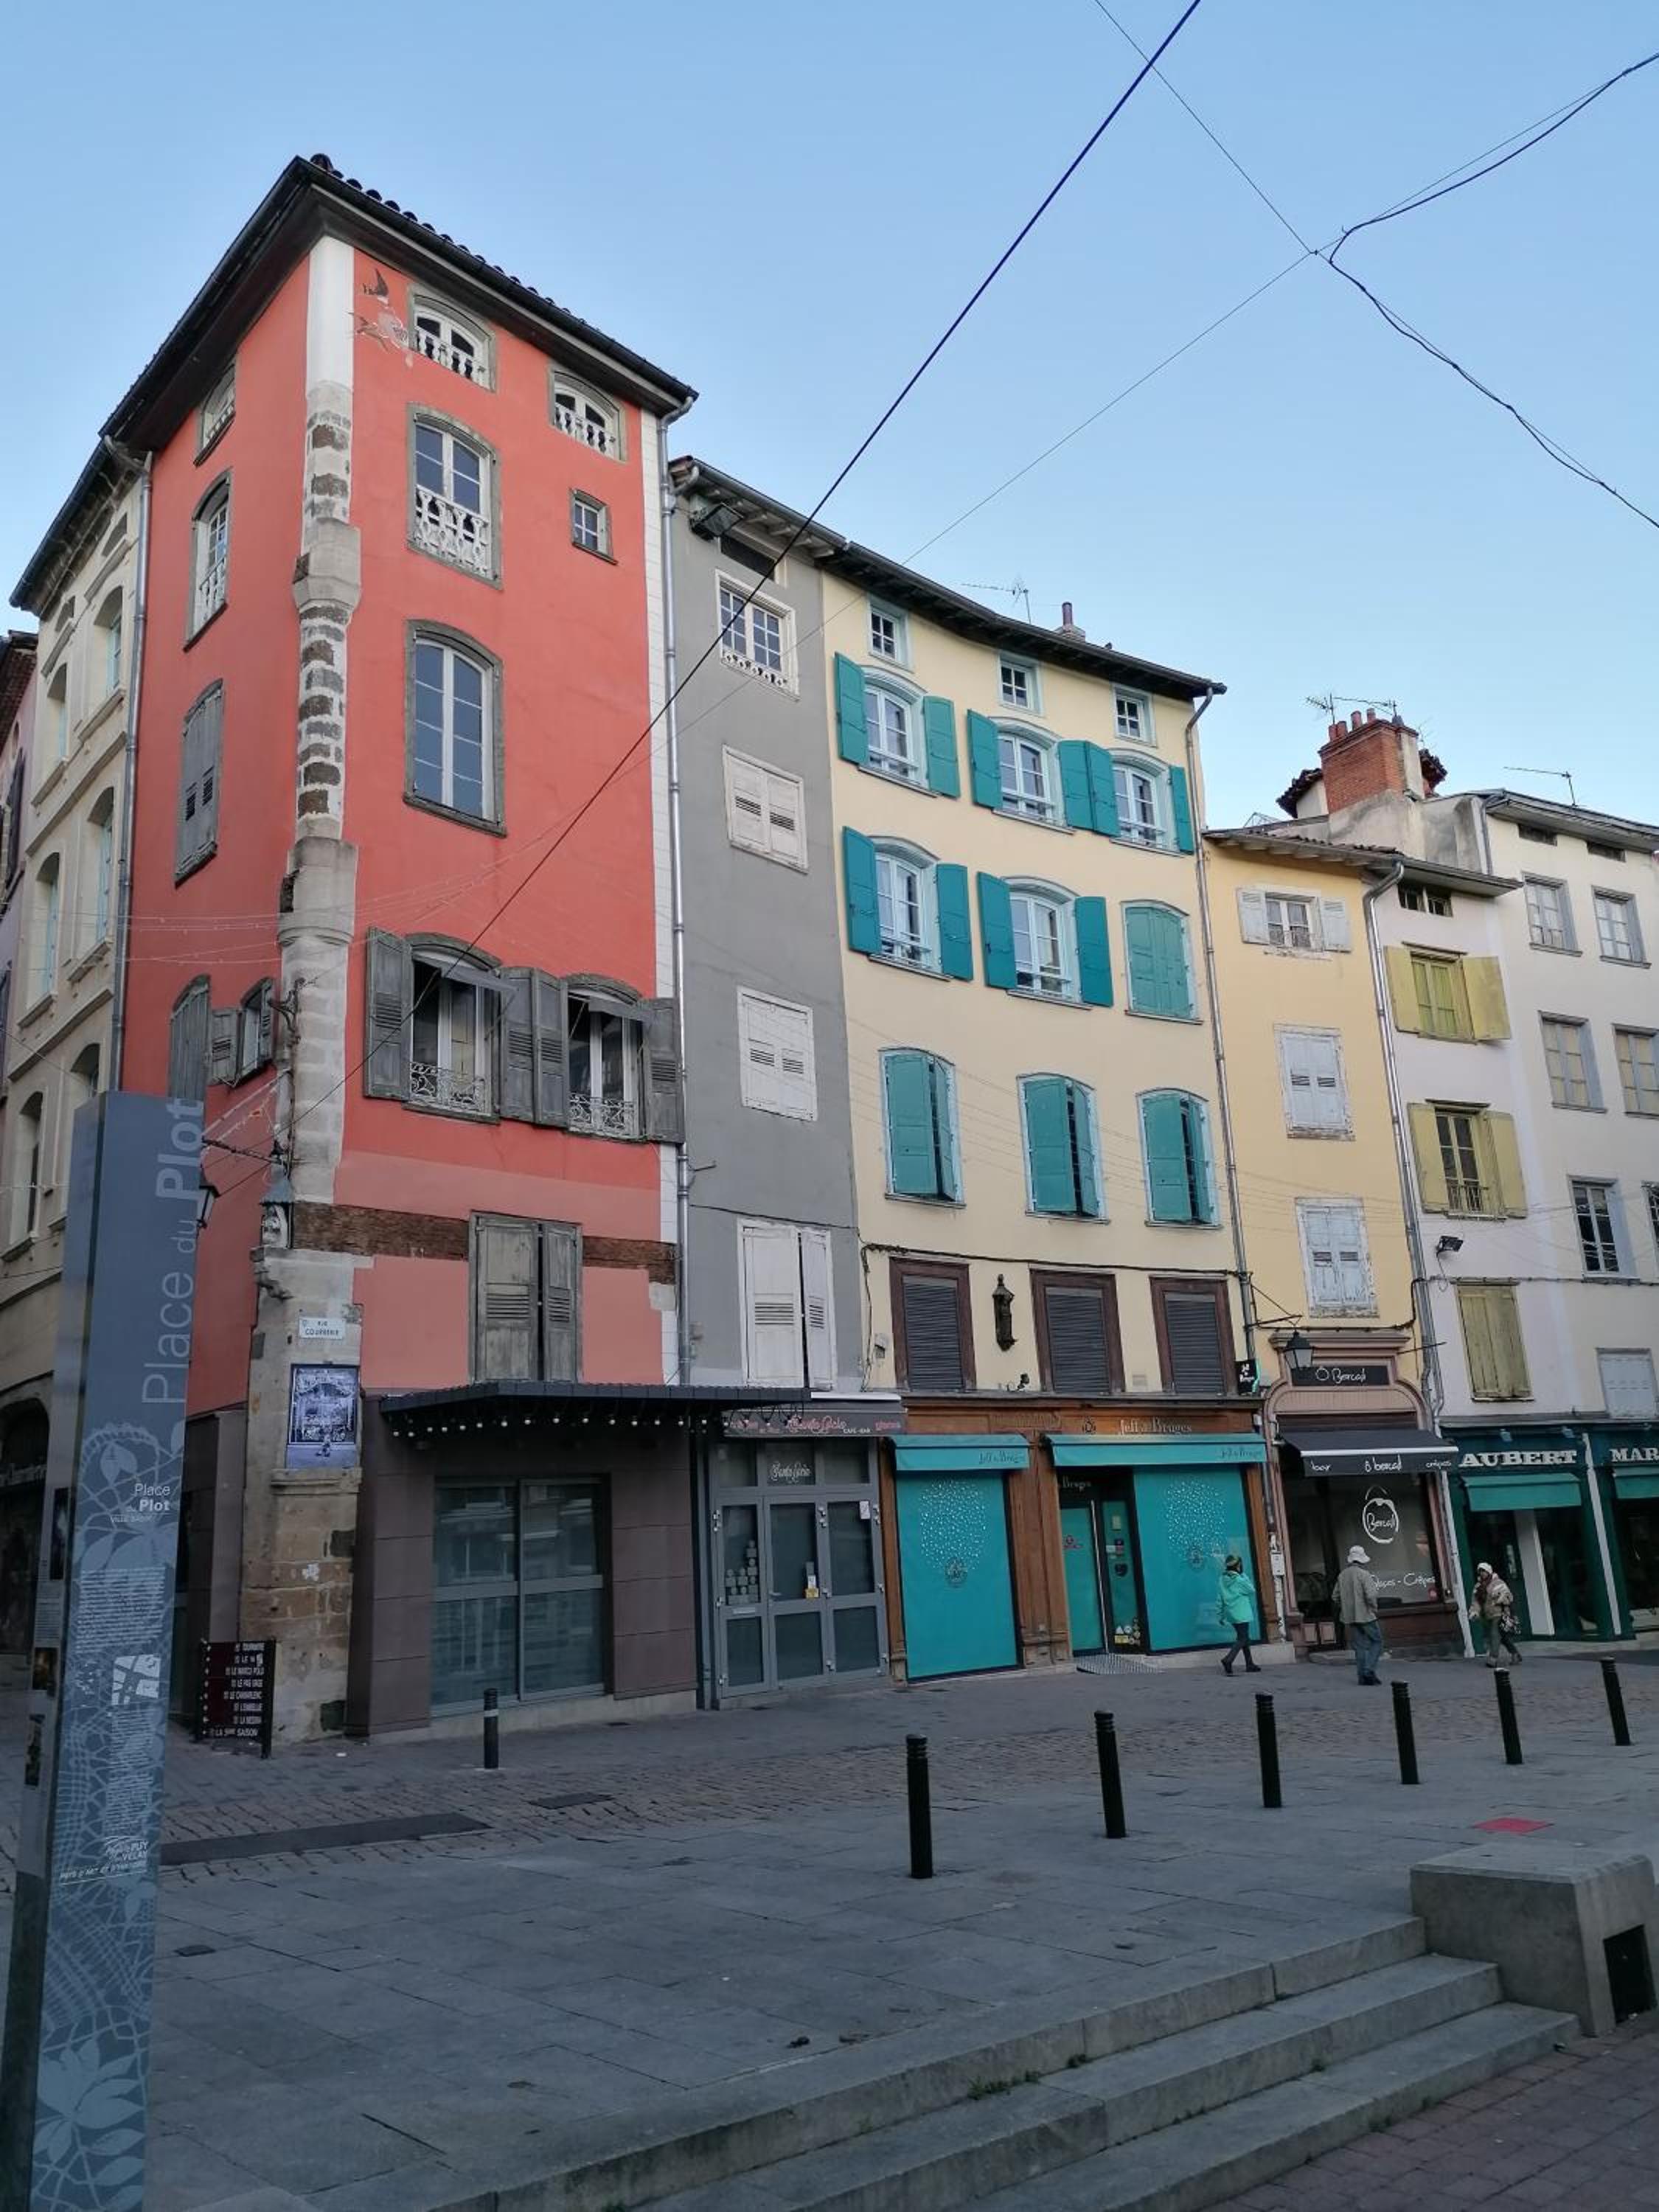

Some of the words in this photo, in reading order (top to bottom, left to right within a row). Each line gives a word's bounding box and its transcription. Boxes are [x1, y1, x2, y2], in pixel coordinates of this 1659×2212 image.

[156, 1098, 205, 1200] Plot
[170, 1219, 197, 1253] du
[142, 1270, 193, 1403] Place
[1458, 1450, 1577, 1467] AUBERT
[134, 1483, 171, 1496] Place
[139, 1498, 170, 1512] Plot
